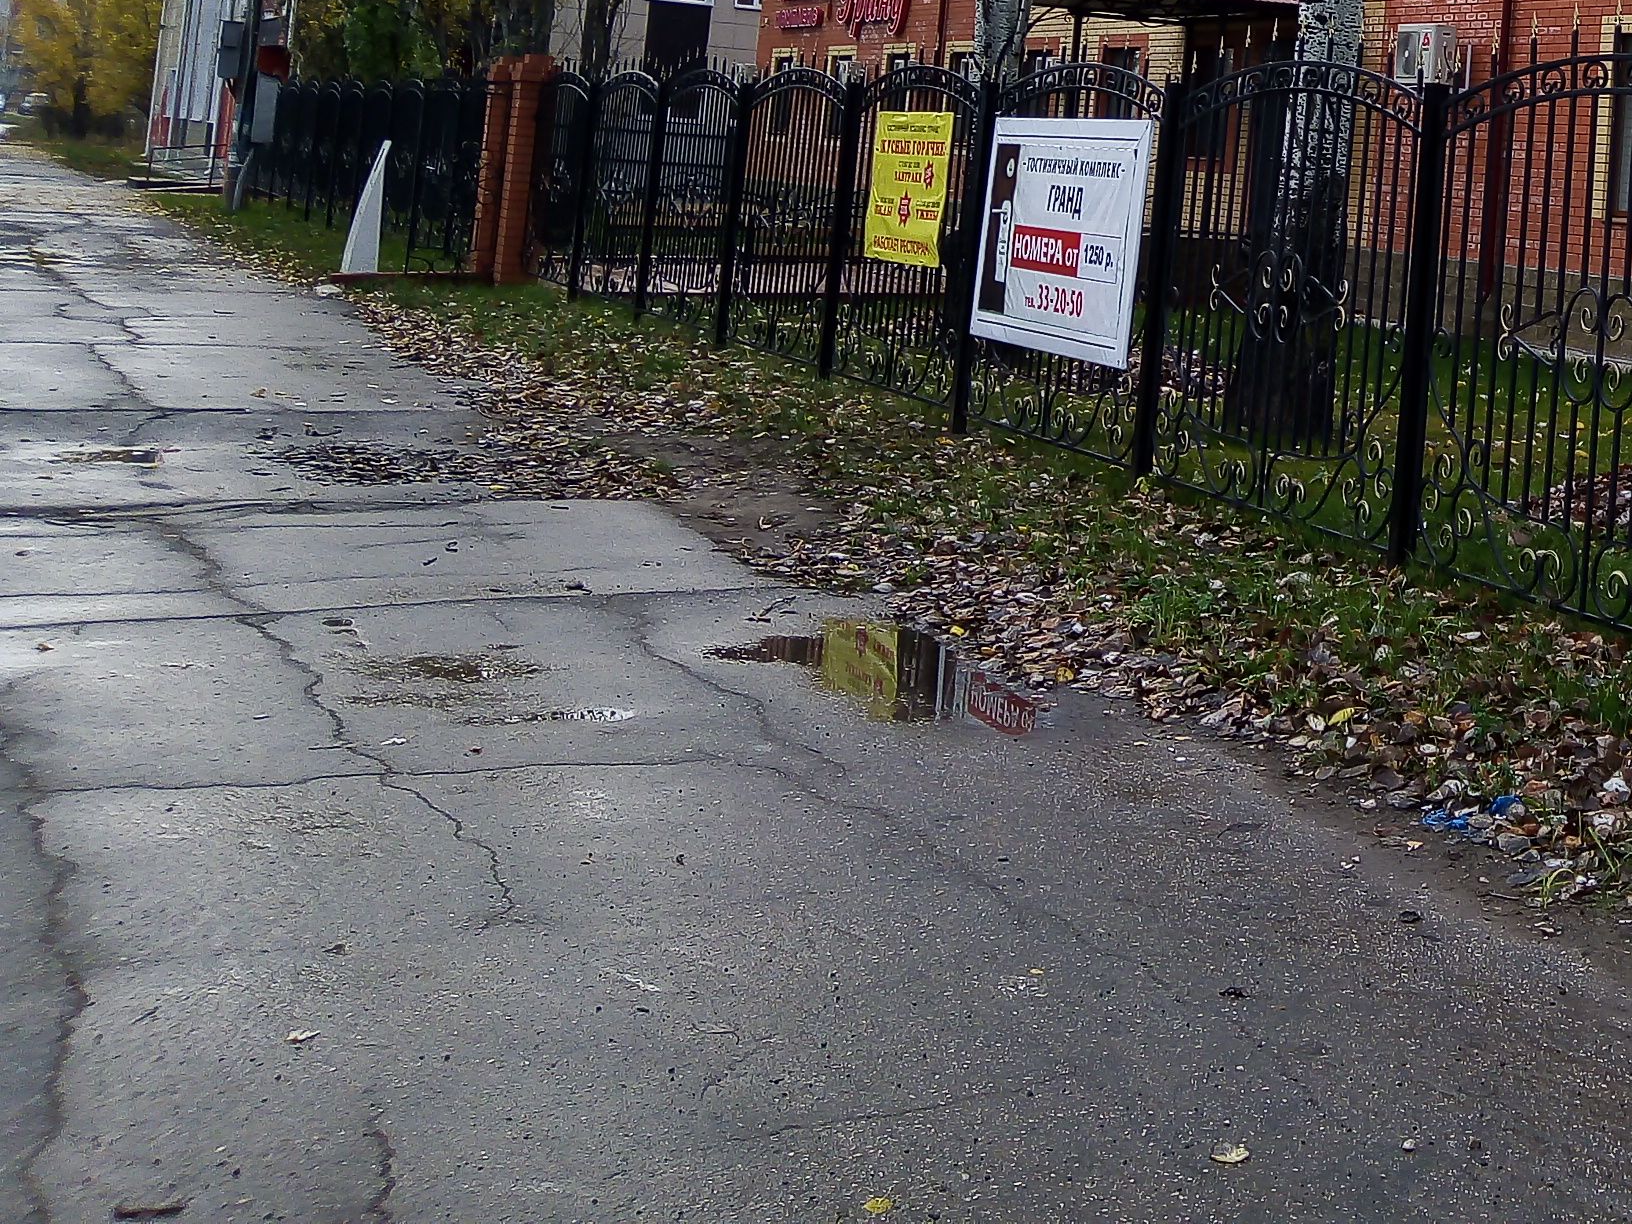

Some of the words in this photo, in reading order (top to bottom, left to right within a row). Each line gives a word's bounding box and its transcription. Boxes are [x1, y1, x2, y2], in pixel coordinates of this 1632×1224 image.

[1046, 184, 1084, 221] ГРАНД
[1013, 233, 1063, 266] НОМЕРА
[1083, 243, 1104, 266] 1250
[1036, 283, 1083, 318] 33-20-50
